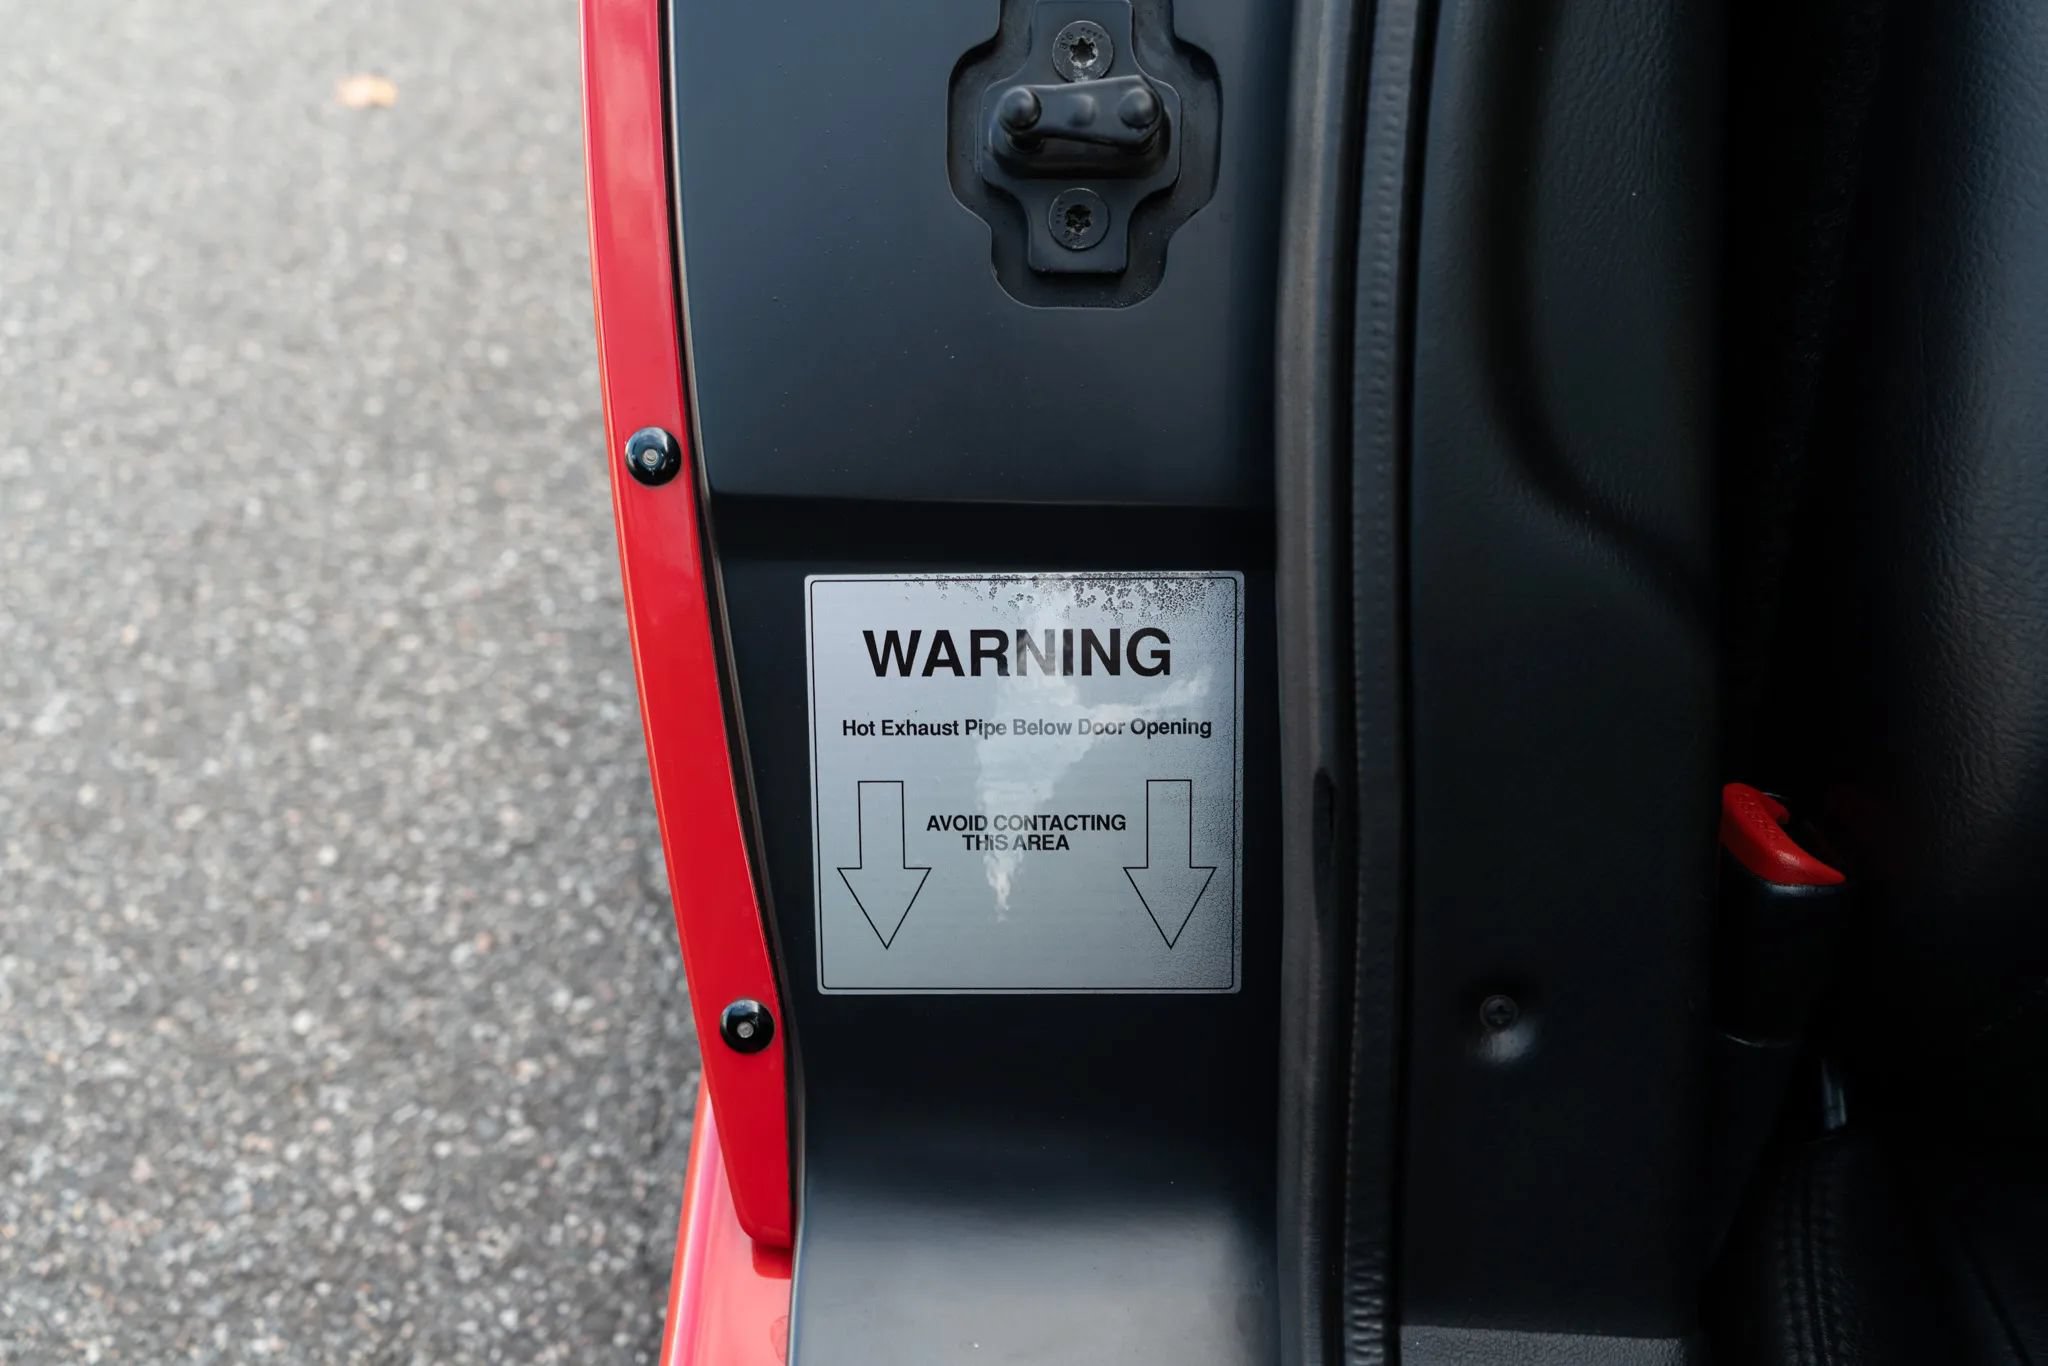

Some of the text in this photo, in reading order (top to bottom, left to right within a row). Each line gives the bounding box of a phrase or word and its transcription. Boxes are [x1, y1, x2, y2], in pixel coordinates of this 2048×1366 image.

[863, 629, 1171, 677] WARNING
[842, 718, 1212, 739] Hot Exhaust Pipe Below Door Opening
[926, 814, 1126, 831] AVOID CONTACTING
[962, 834, 1070, 850] THIS AREA
